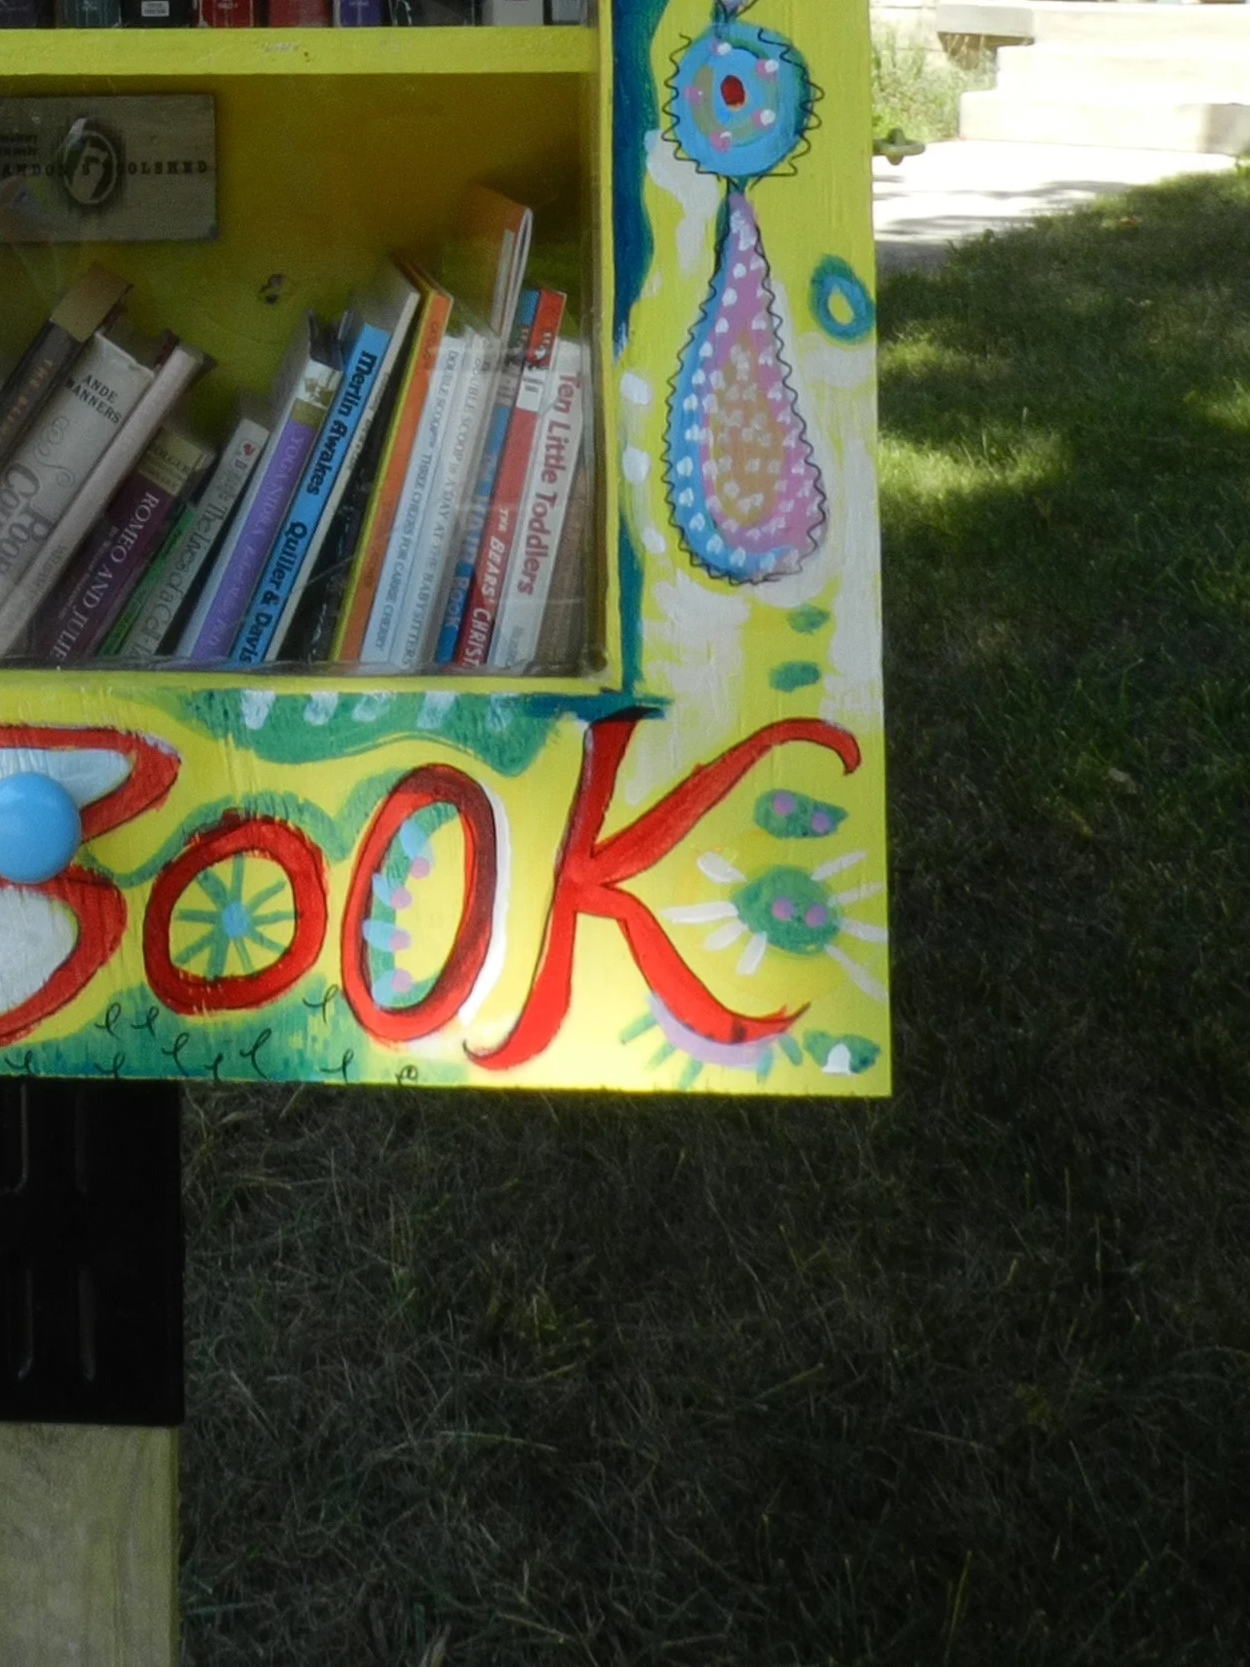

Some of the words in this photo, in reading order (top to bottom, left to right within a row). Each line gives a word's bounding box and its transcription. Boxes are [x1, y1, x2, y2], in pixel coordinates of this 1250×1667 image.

[77, 371, 122, 406] ANDE
[332, 348, 383, 421] Merlin
[436, 349, 461, 398] DOUBLE
[549, 369, 585, 417] Ten
[271, 432, 307, 485] YOGA
[299, 416, 353, 499] Awakes
[449, 413, 475, 463] SCOOP
[533, 418, 576, 487] Little
[413, 451, 434, 491] THREE
[105, 488, 164, 568] ROMEO
[193, 498, 229, 539] The
[246, 480, 286, 540] NIDRA
[431, 520, 447, 540] AT
[260, 517, 311, 593] Quiller
[395, 535, 412, 562] FOR
[474, 534, 511, 605] BEARS'
[509, 488, 564, 598] Toddlers
[77, 561, 120, 614] AND
[259, 588, 281, 610] &
[384, 560, 407, 604] CARRIE
[235, 608, 276, 667] Davis
[372, 604, 396, 651] CHERRY
[398, 570, 437, 668] BABYSITTERS
